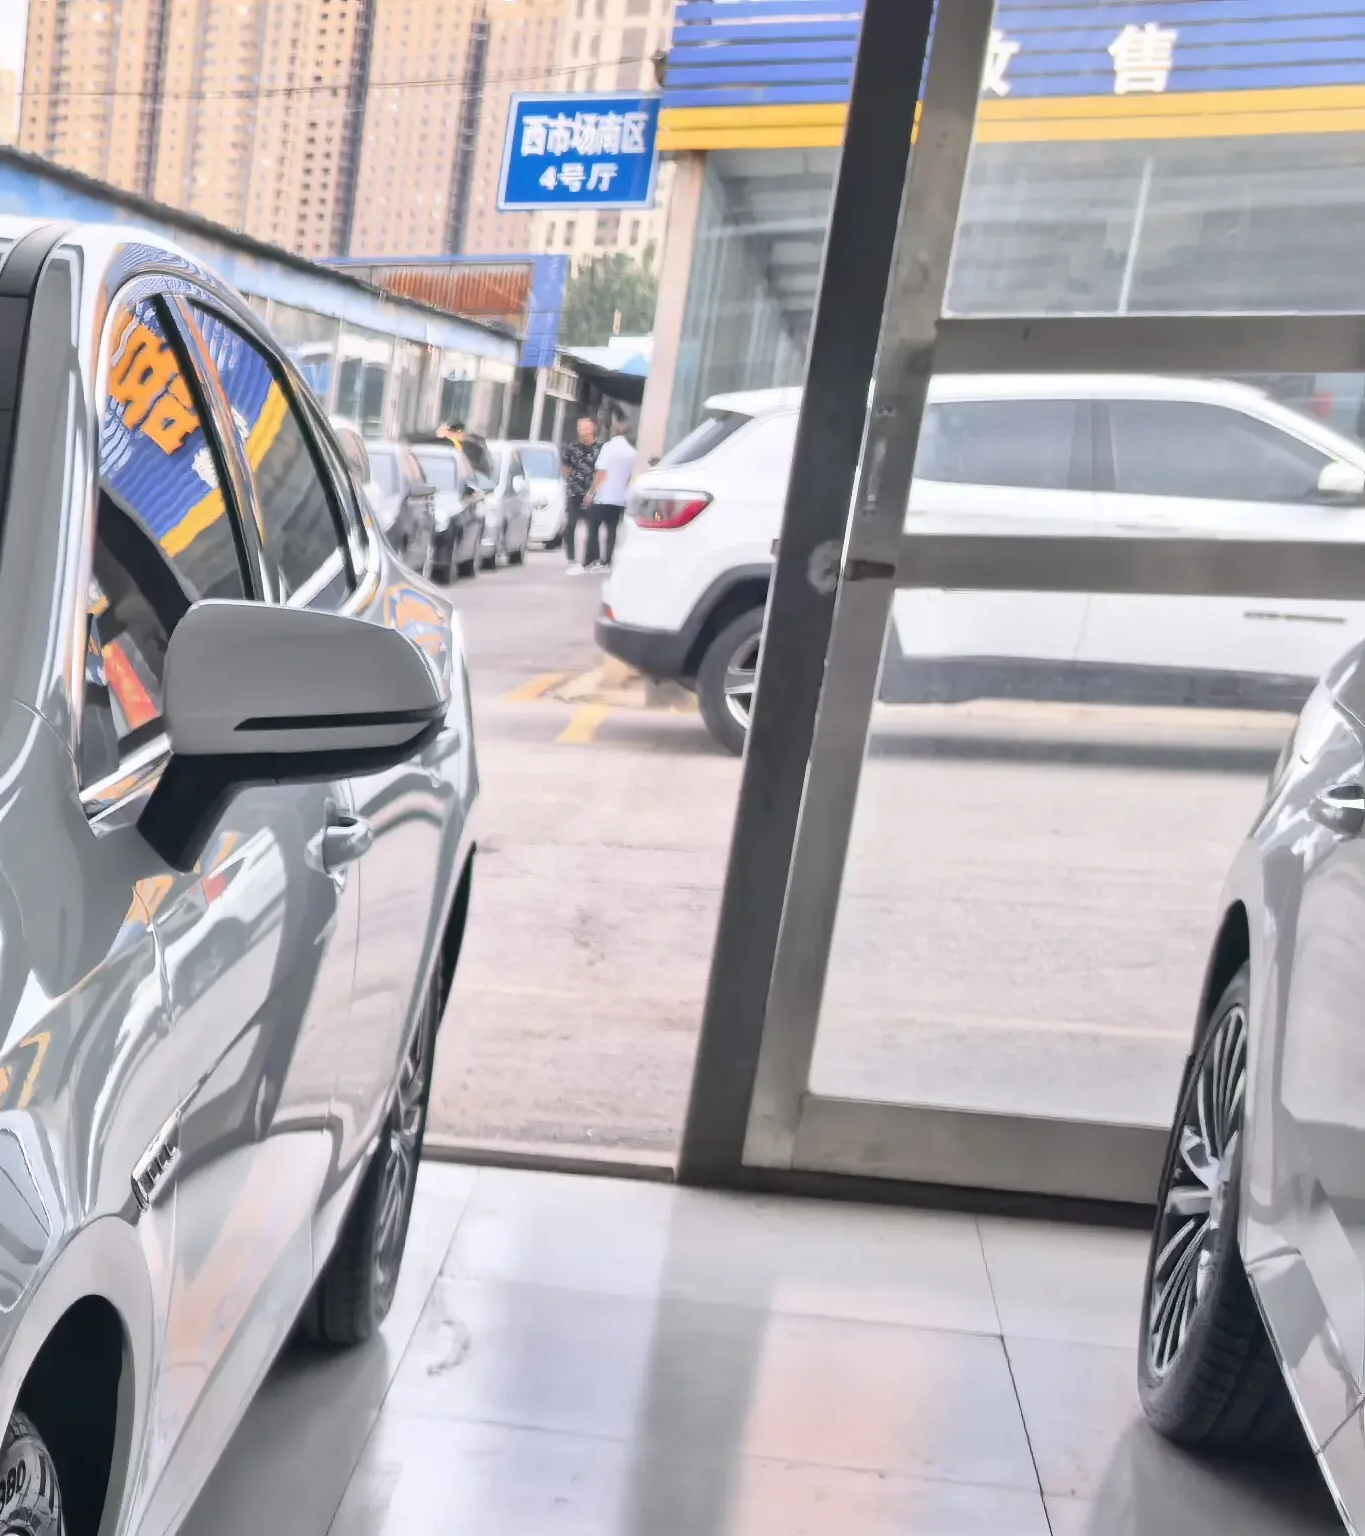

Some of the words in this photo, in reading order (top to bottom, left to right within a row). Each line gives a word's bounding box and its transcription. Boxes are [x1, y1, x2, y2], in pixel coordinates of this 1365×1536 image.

[521, 109, 649, 157] 西市场南区
[539, 162, 618, 192] 4号厅
